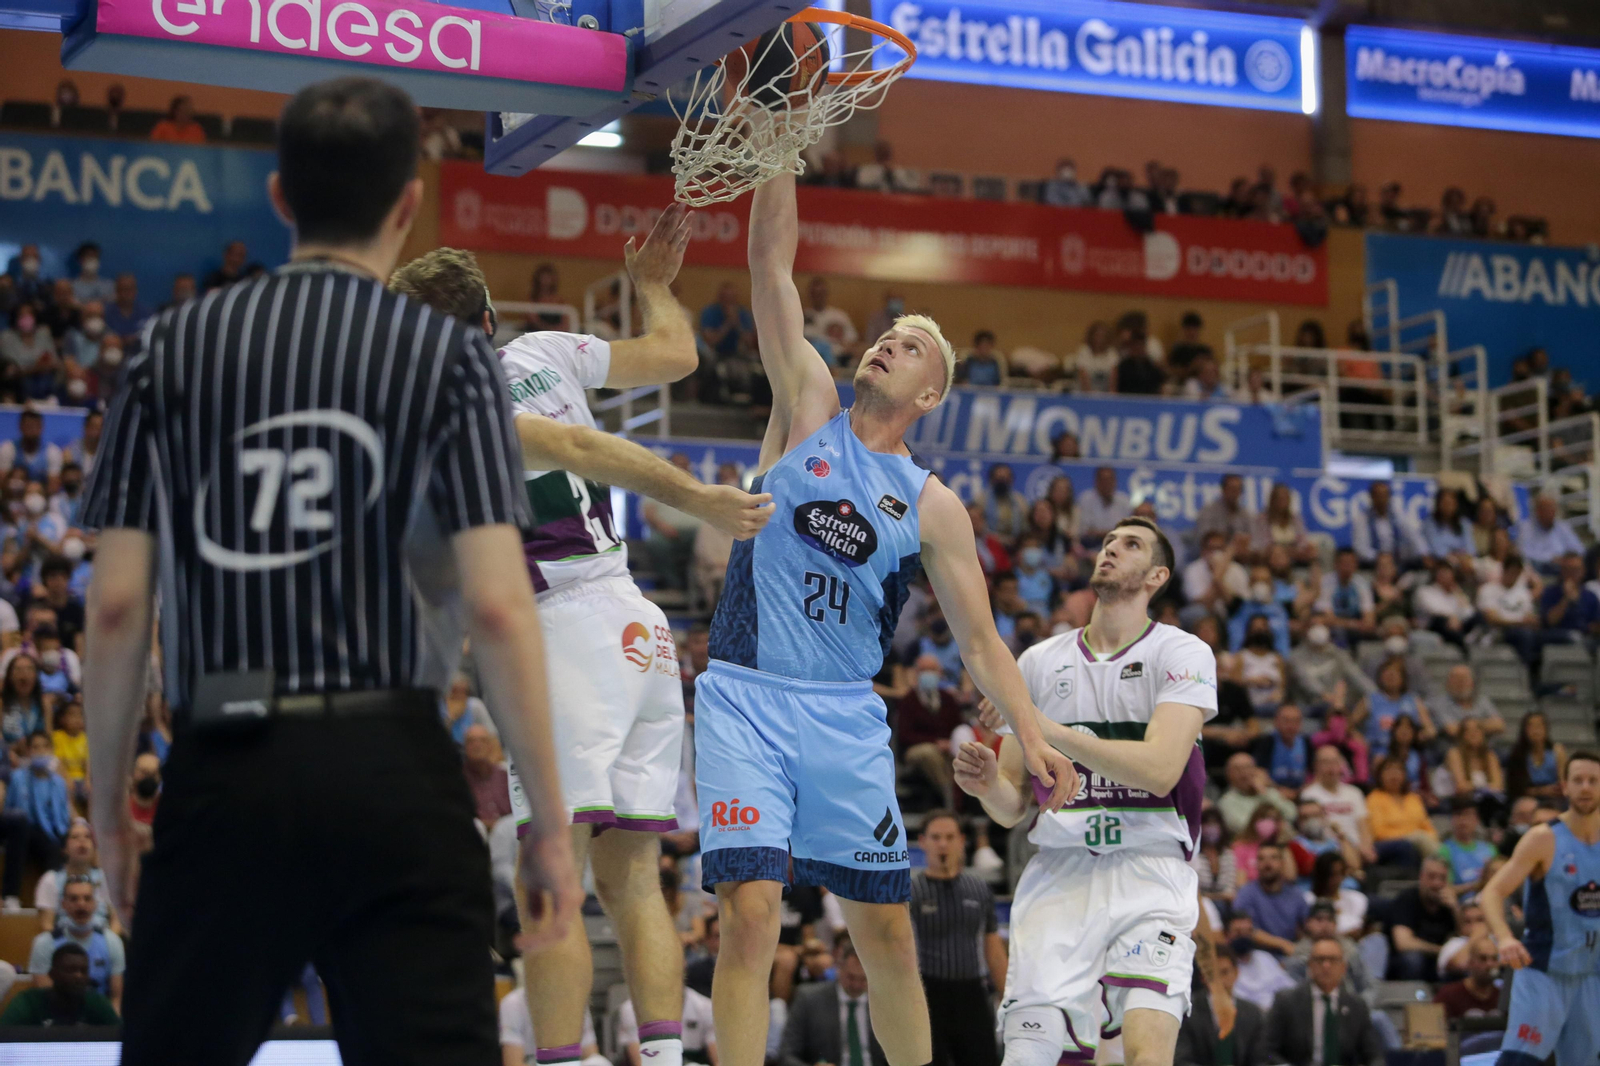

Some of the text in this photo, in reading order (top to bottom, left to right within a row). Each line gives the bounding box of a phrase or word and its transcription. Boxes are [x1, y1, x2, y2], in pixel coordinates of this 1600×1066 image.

[889, 2, 1238, 86] Estrella Galicia
[0, 147, 213, 213] BANCA
[238, 448, 334, 533] 72
[806, 507, 867, 543] Estrella
[808, 520, 858, 557] Galicia
[803, 569, 850, 625] 24
[712, 798, 760, 827] Río
[1085, 814, 1121, 846] 32
